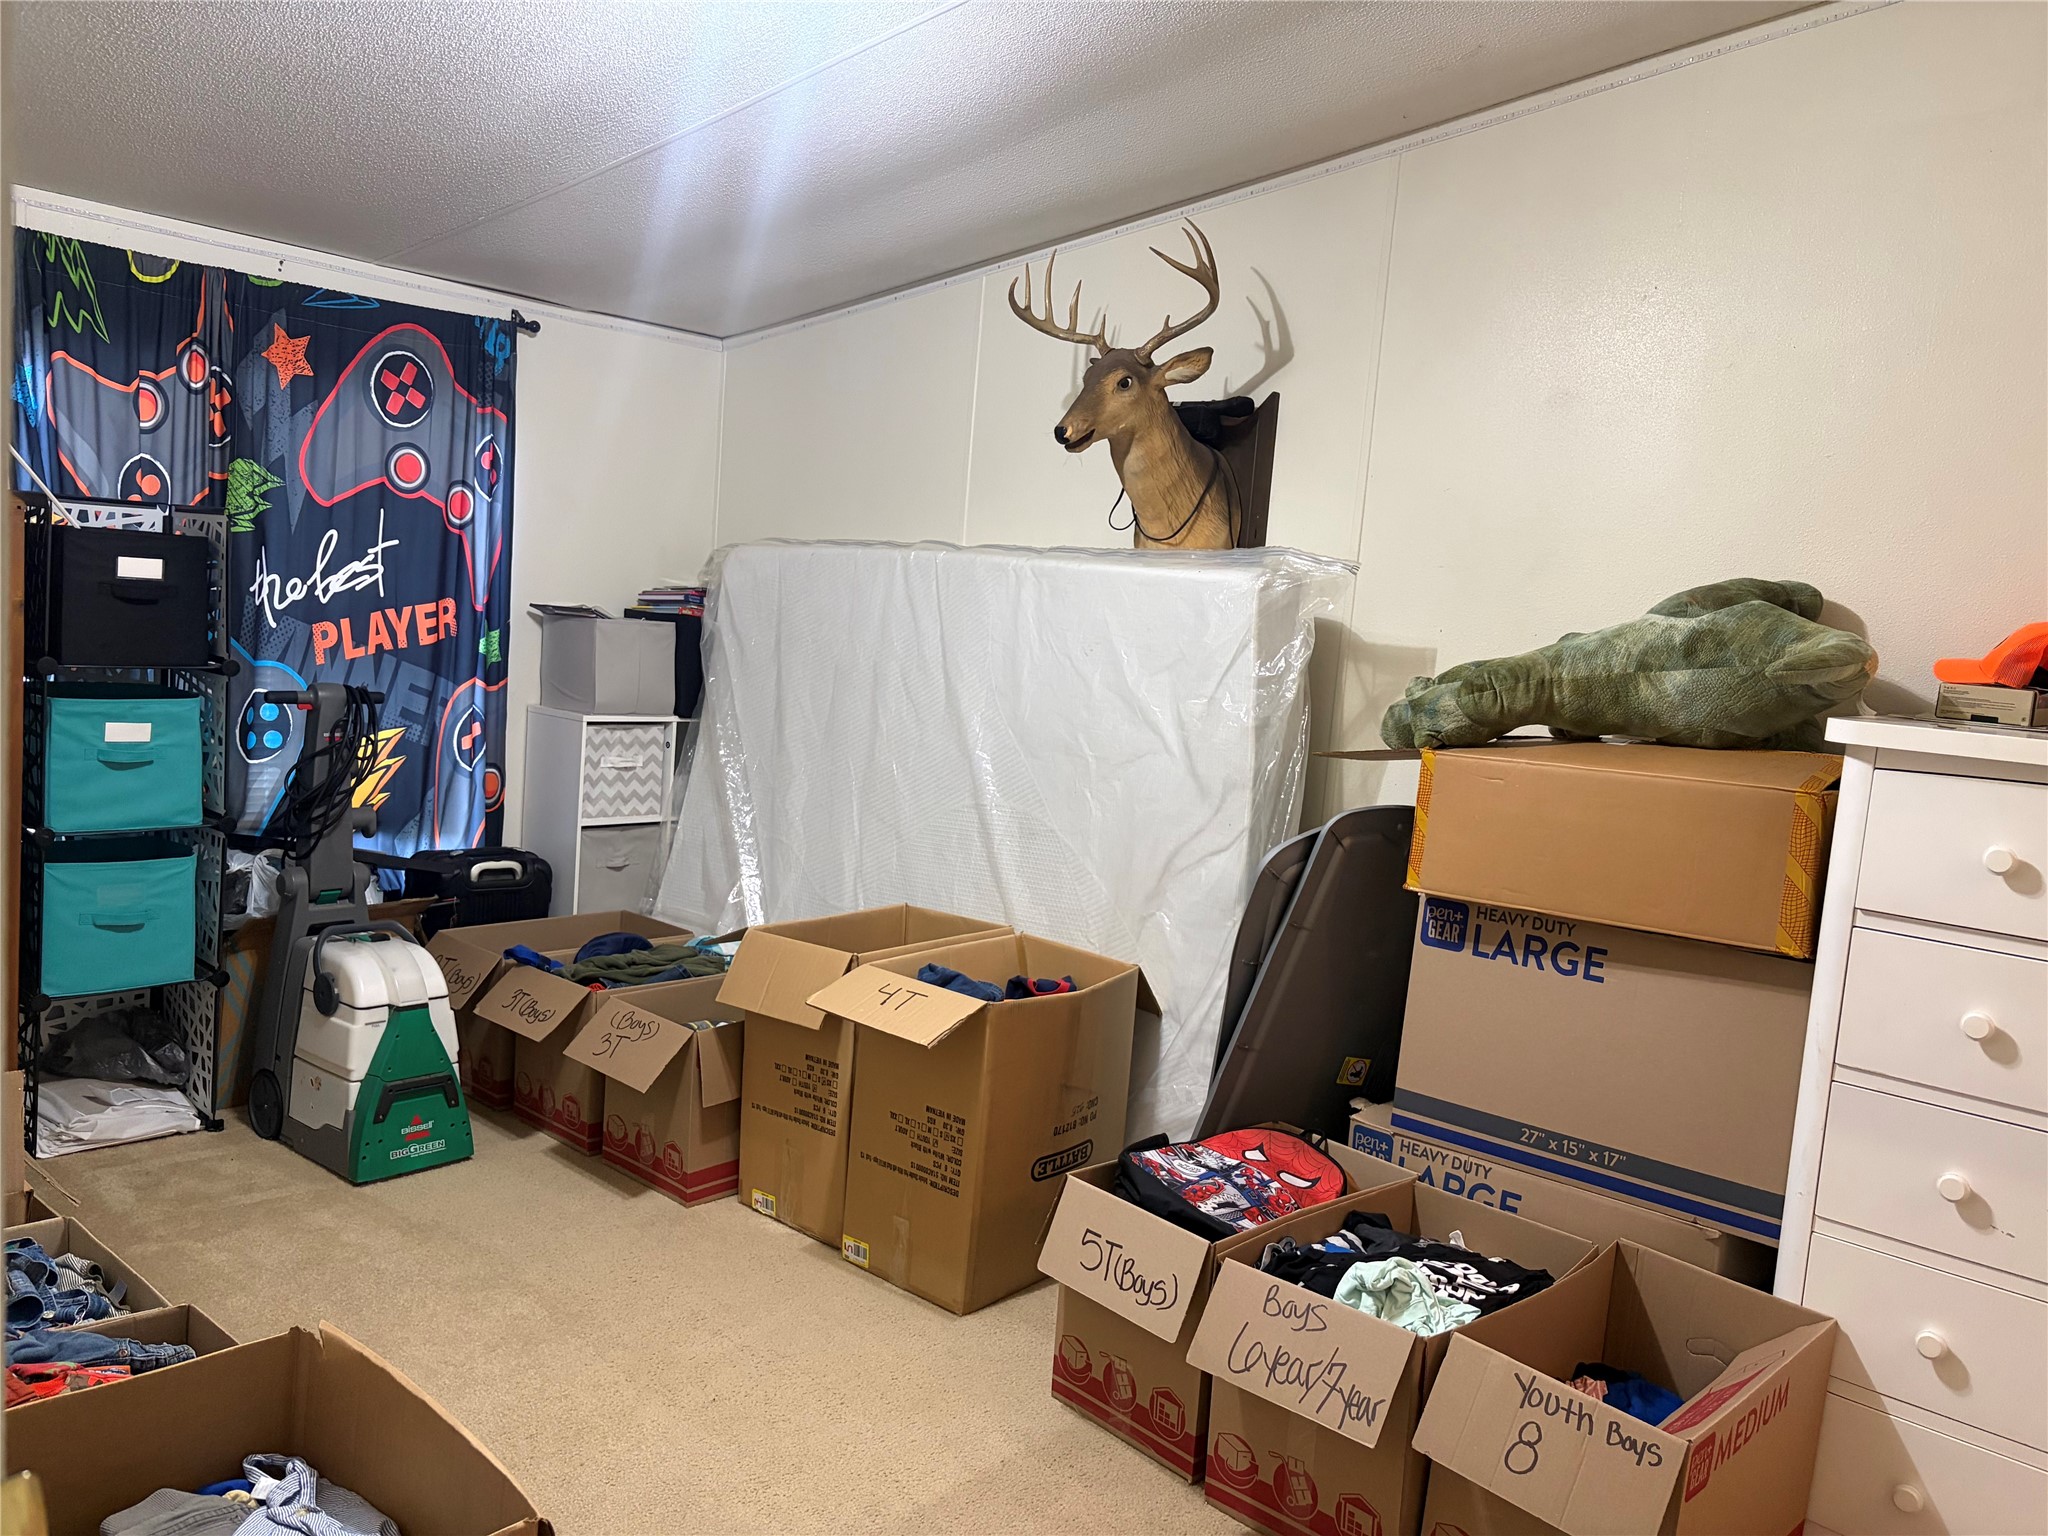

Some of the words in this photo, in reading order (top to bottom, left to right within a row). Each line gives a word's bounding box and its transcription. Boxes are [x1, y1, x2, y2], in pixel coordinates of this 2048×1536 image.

[250, 546, 307, 628] the
[307, 508, 399, 604] best
[312, 597, 457, 665] PLAYER
[1428, 919, 1460, 943] GEAR
[1476, 906, 1529, 928] HEAVY
[1532, 916, 1577, 937] DUTY
[1472, 923, 1608, 983] LARGE
[878, 983, 929, 1011] 4T
[592, 1033, 630, 1058] 3T
[1038, 1145, 1088, 1176] BATTLE
[1400, 1140, 1449, 1165] HEAVY
[1451, 1156, 1492, 1179] DUTY
[1519, 1128, 1545, 1143] 27"
[1562, 1140, 1585, 1156] 15"
[1602, 1152, 1627, 1167] 17"
[1262, 1284, 1328, 1331] Boys
[1514, 1372, 1594, 1435] Youth
[1606, 1421, 1663, 1466] Boys
[1714, 1377, 1790, 1471] MEDIUM
[1504, 1421, 1543, 1474] 8
